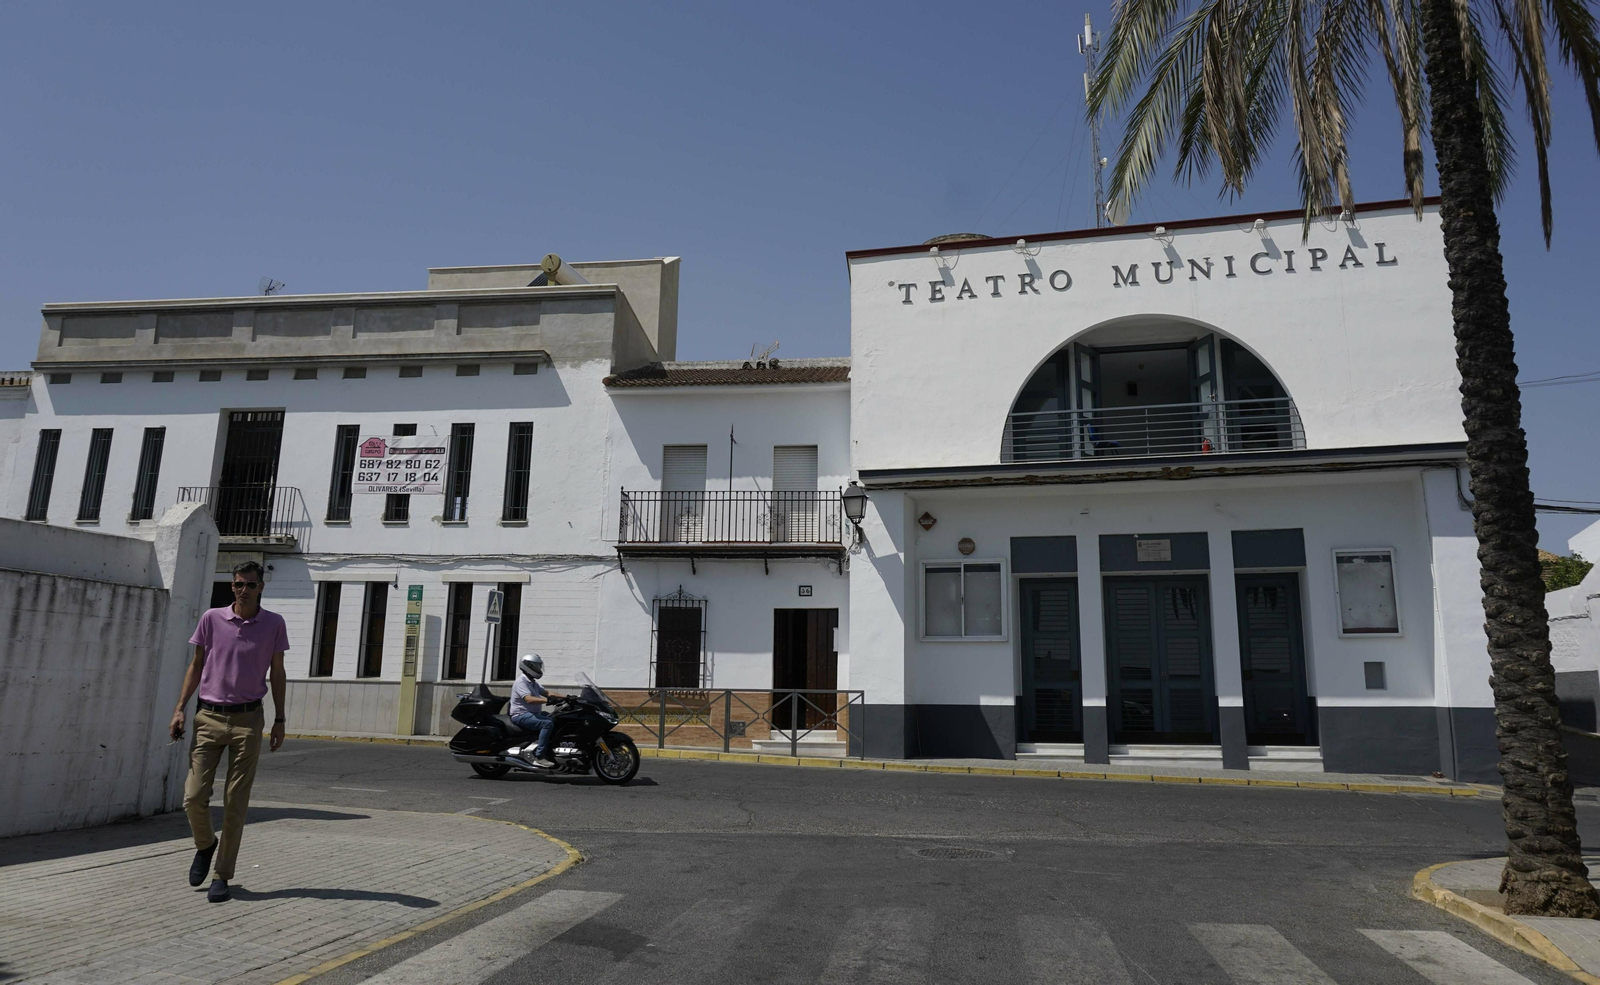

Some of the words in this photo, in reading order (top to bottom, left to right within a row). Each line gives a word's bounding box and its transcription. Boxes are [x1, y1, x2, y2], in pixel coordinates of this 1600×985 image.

[898, 269, 1073, 305] TEATRO
[1112, 242, 1398, 288] MUNICIPAL
[360, 460, 382, 469] 687
[386, 460, 402, 469] 82
[405, 460, 421, 469] 80
[425, 460, 440, 469] 62
[358, 473, 381, 482] 637
[387, 473, 398, 482] 17
[405, 473, 416, 482] 18
[423, 473, 438, 482] 04
